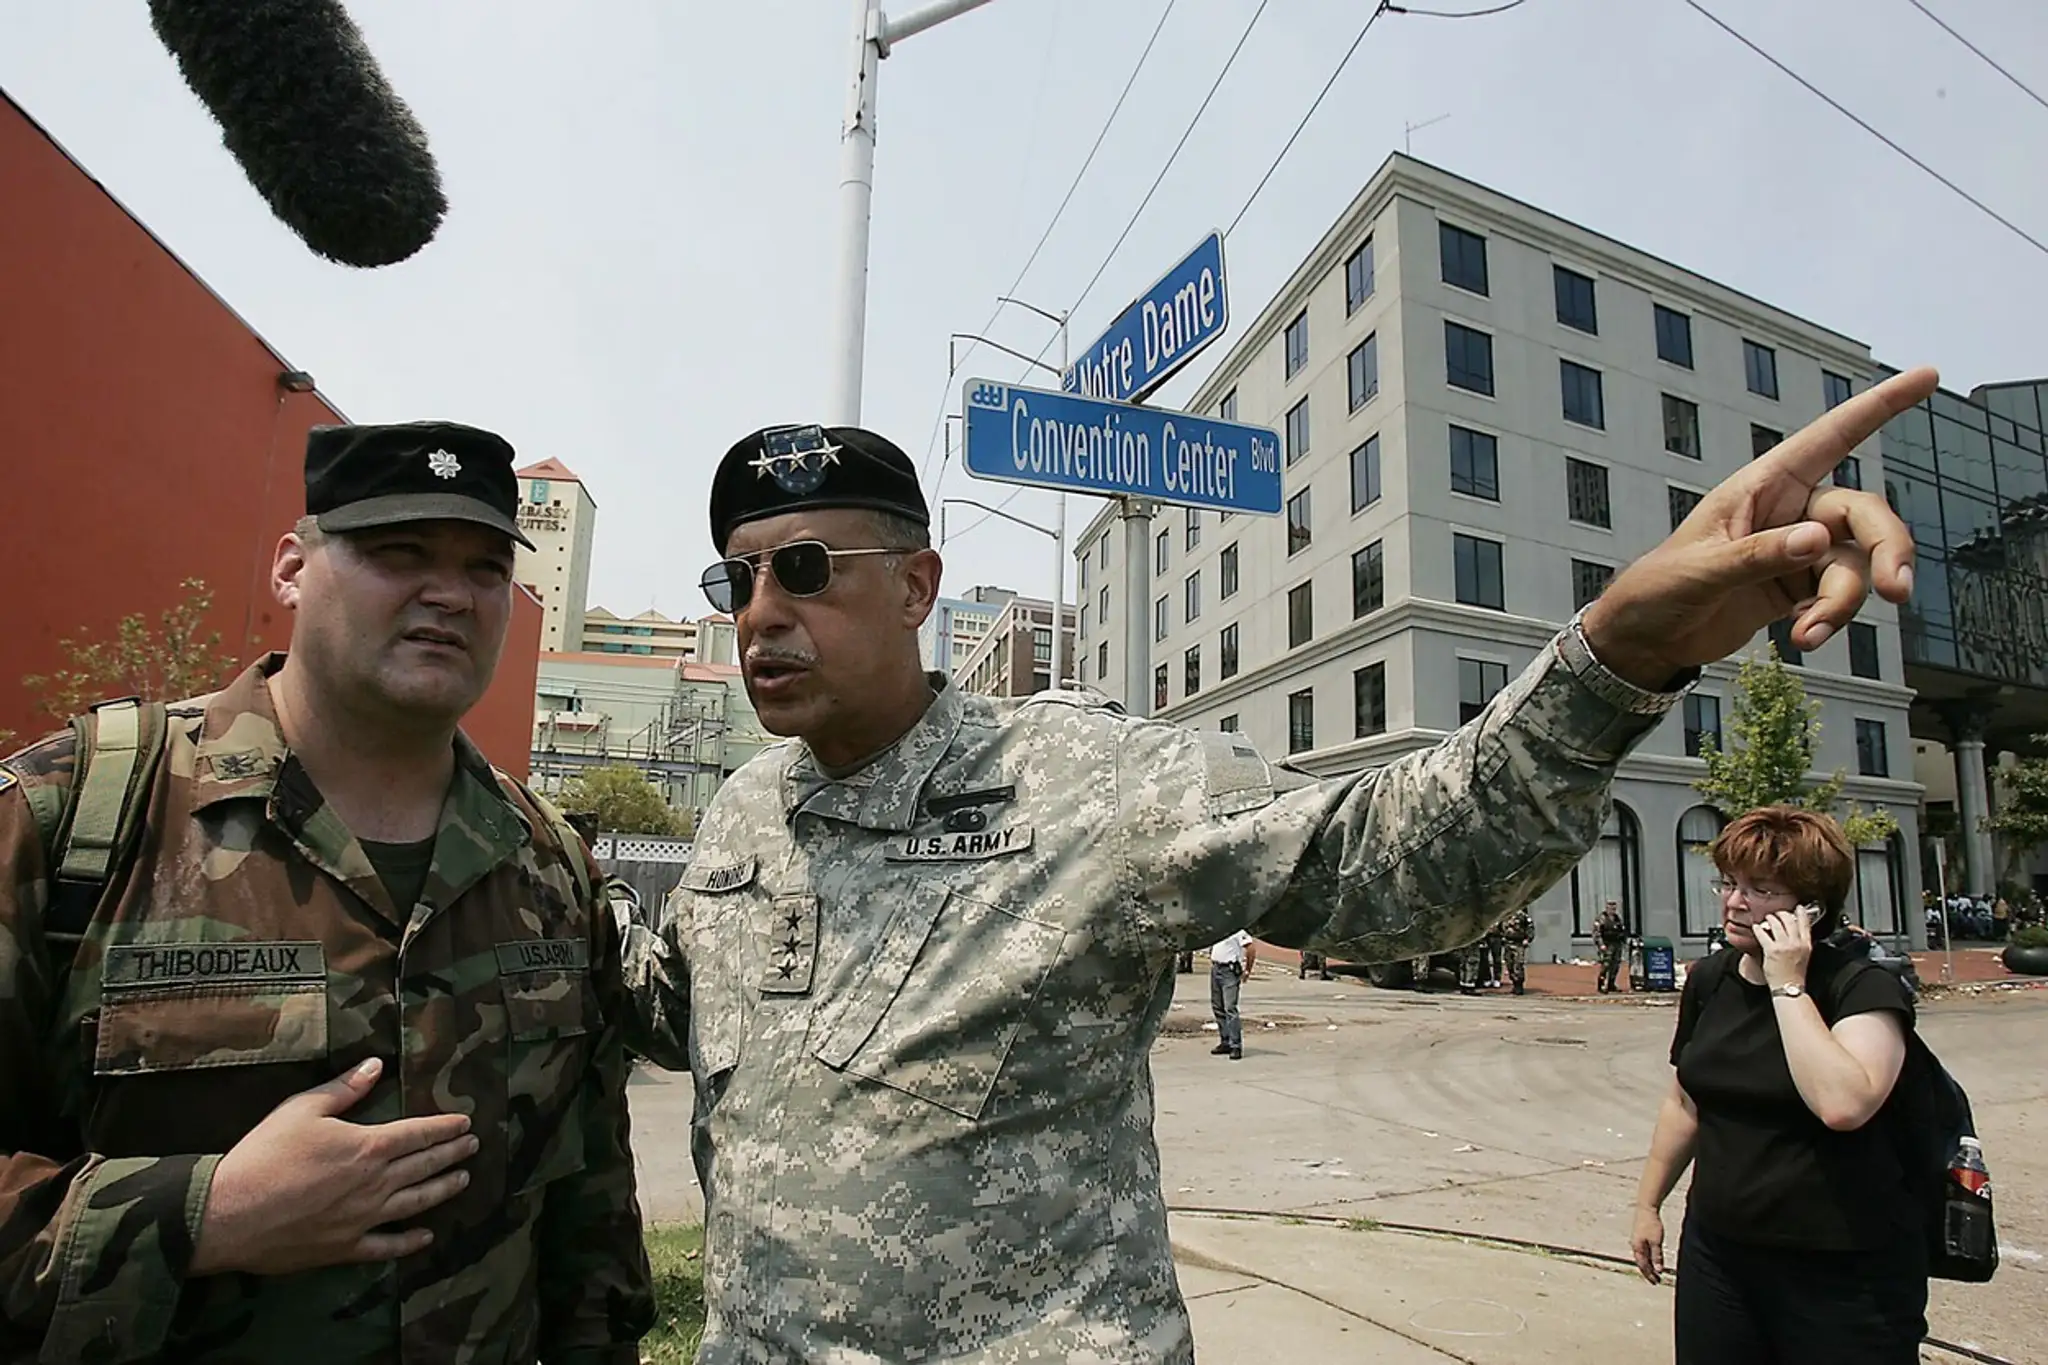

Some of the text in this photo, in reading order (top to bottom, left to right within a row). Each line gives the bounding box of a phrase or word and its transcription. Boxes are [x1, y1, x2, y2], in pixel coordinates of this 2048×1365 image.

[1080, 267, 1215, 399] Notre Dame
[1012, 398, 1275, 500] Convention Center Blvd
[519, 505, 570, 519] BASSY
[905, 827, 1015, 855] U.S. ARMY
[132, 947, 301, 979] THIBODEAUX
